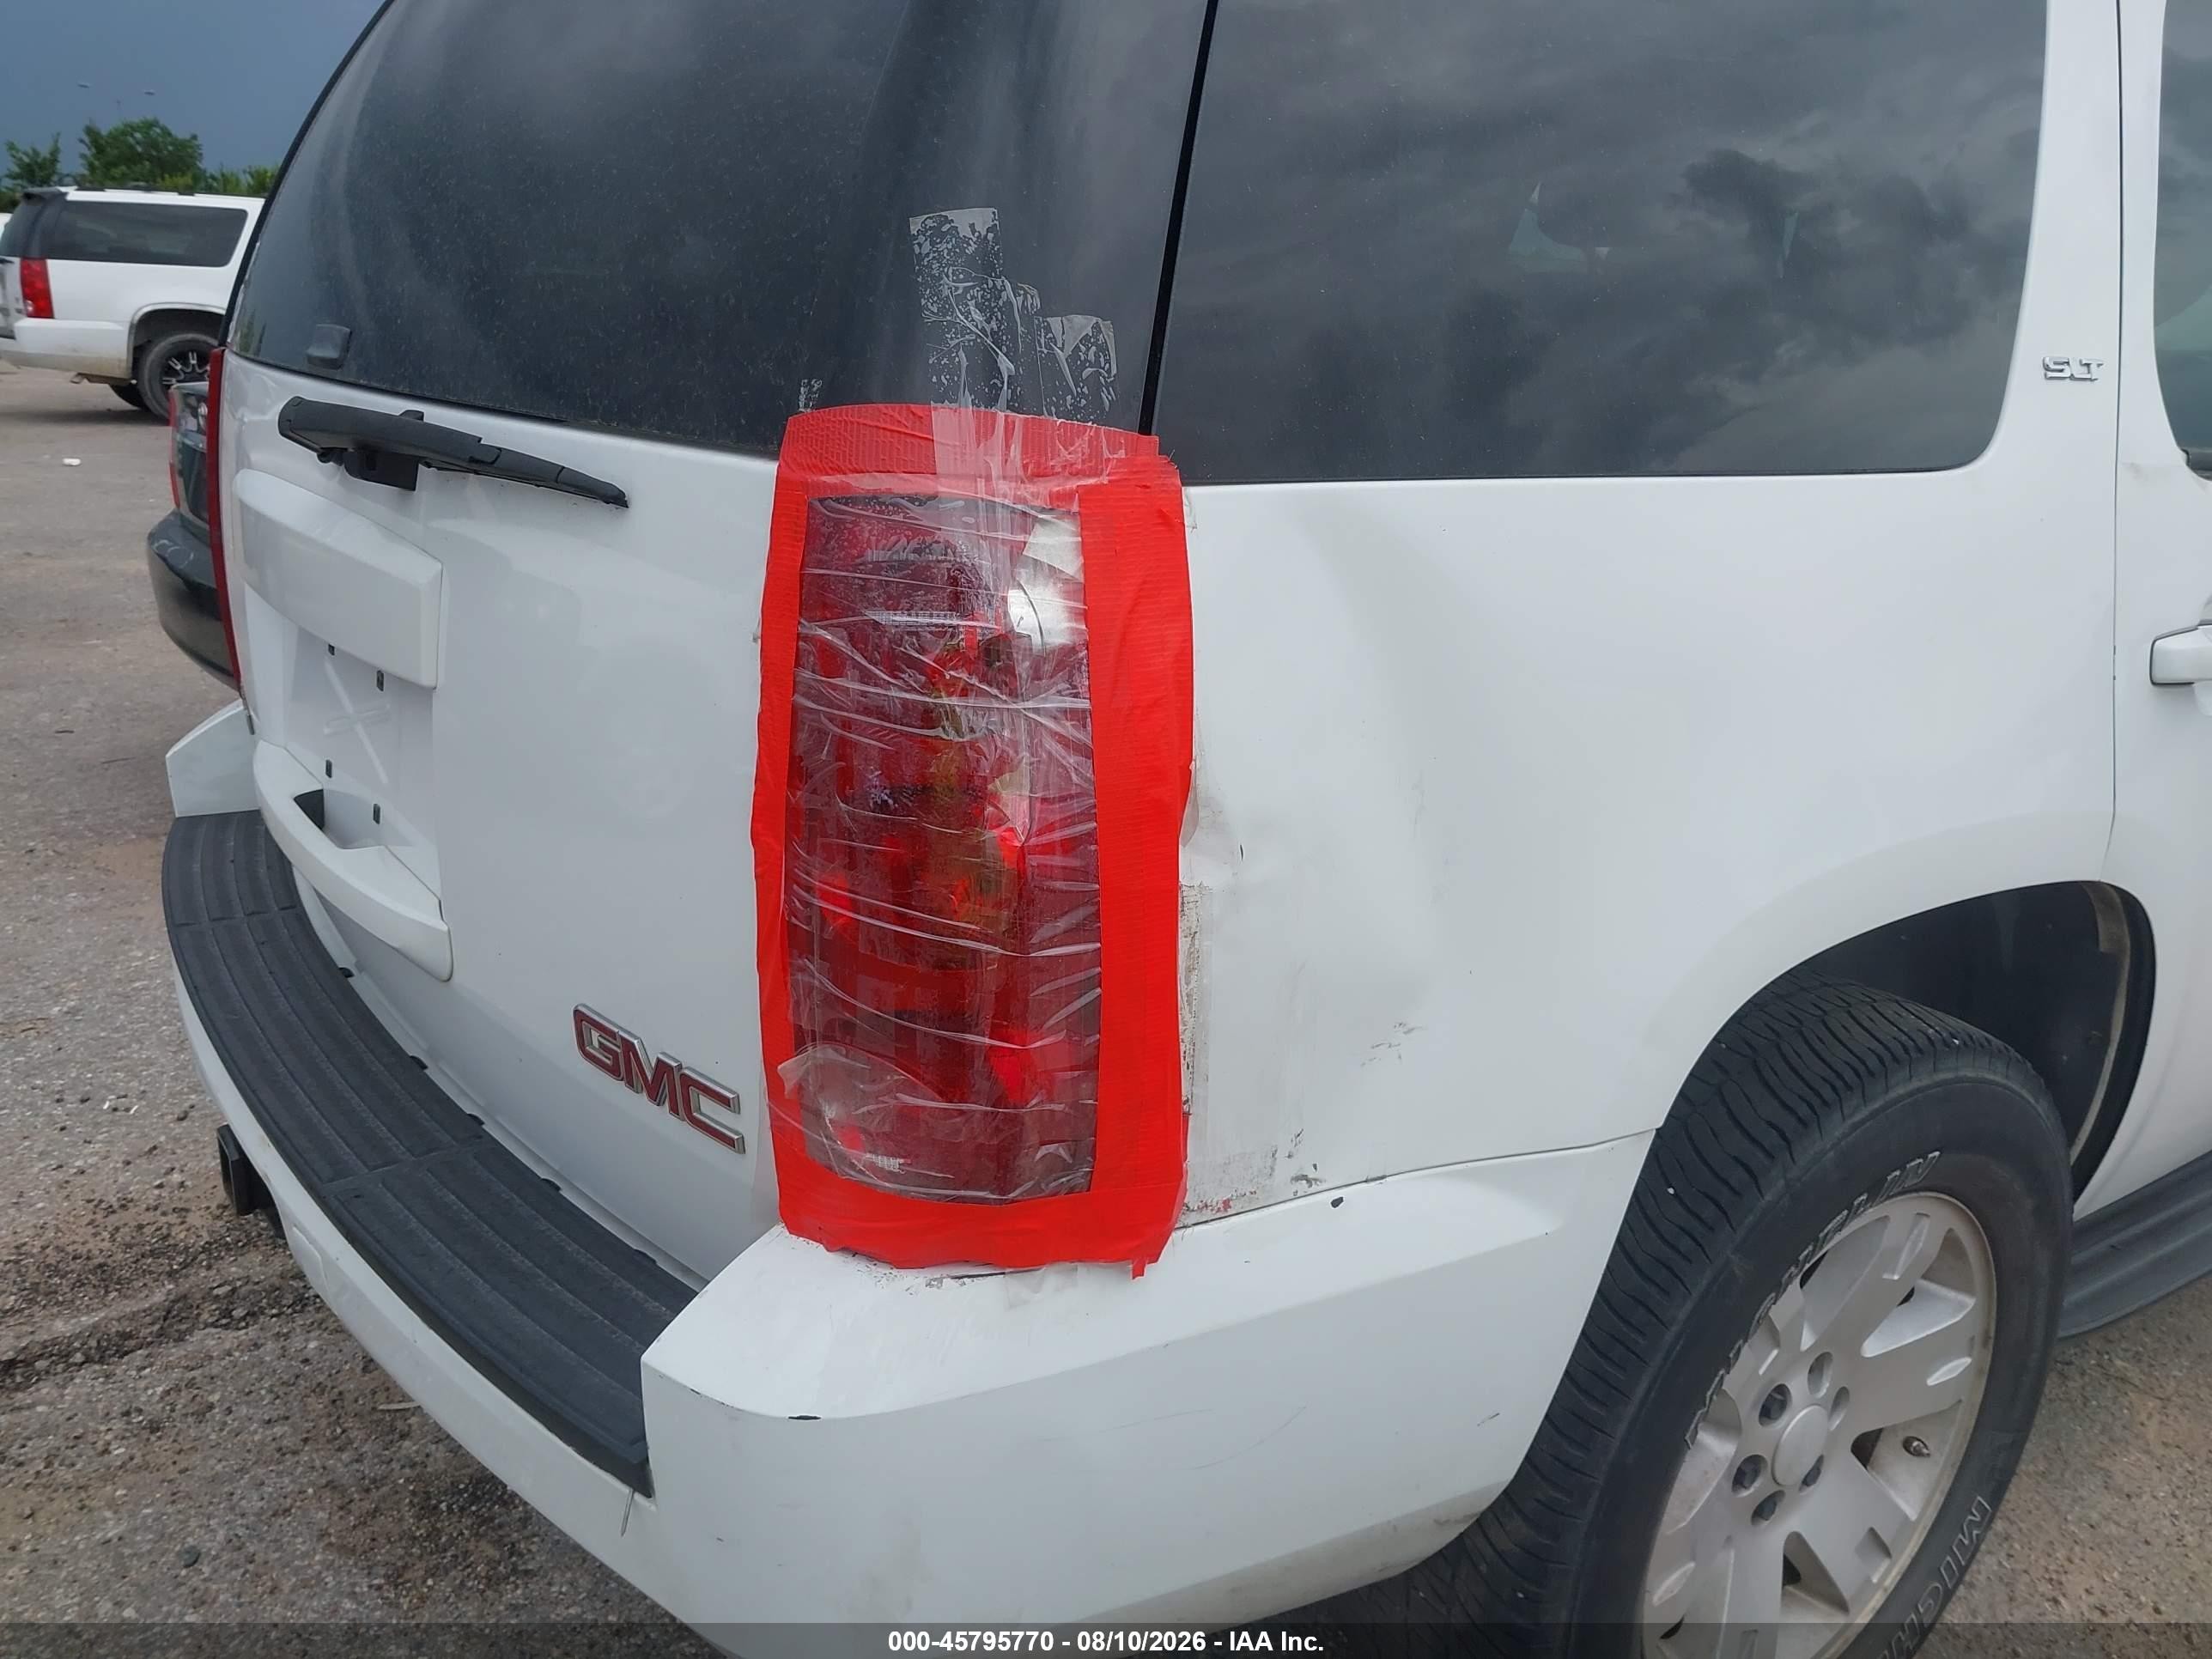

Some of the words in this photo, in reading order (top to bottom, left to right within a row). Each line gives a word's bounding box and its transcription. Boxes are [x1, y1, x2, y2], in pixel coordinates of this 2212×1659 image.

[2043, 356, 2104, 381] SLT
[573, 1003, 745, 1154] GMC
[1877, 1496, 1992, 1659] MICH
